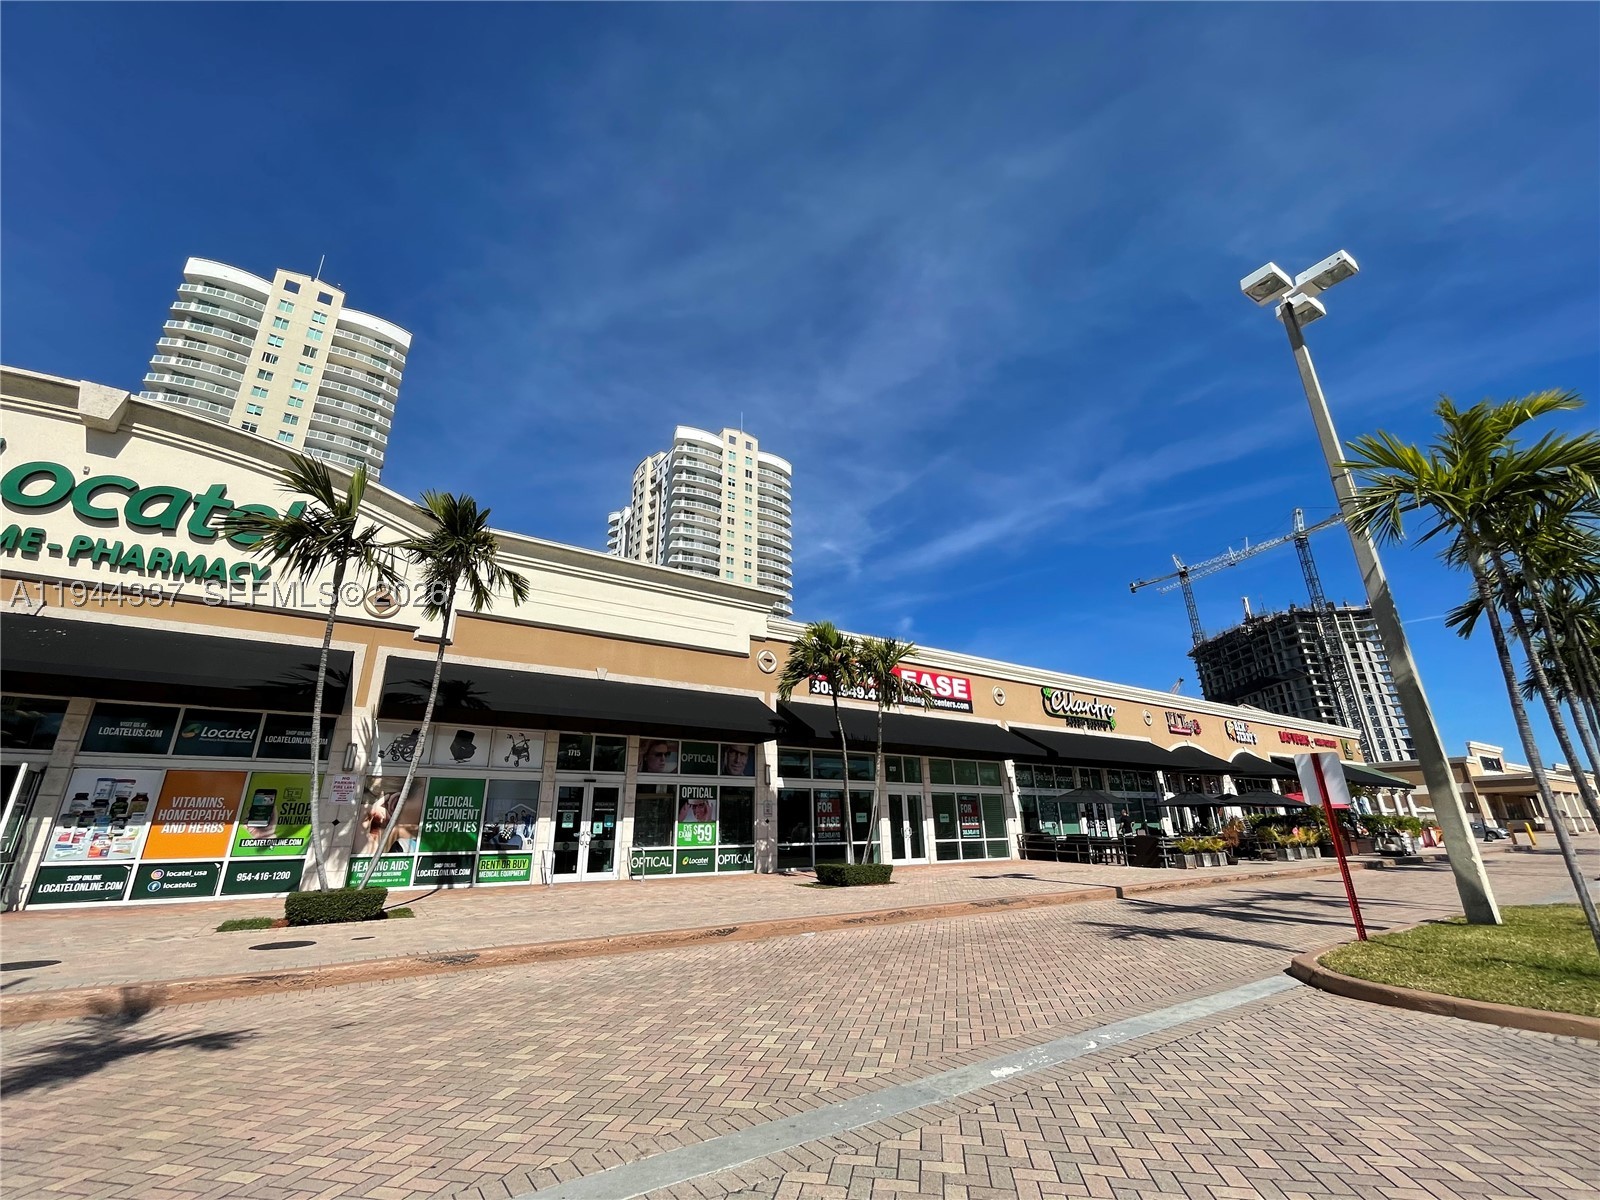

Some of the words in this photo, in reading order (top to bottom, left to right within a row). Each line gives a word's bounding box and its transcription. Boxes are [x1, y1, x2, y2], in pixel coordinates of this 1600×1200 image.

[67, 535, 271, 590] PHARMACY
[1051, 690, 1116, 717] Cilantro
[98, 726, 164, 738] LOCATELUS.COM
[201, 726, 256, 740] Locatel
[681, 753, 716, 764] OPTICAL
[681, 786, 714, 799] OPTICAL
[172, 796, 226, 809] VITAMINS,
[433, 795, 474, 808] MEDICAL
[817, 802, 833, 813] FOR
[426, 808, 479, 820] EQUIPMENT
[960, 803, 972, 813] FOR
[158, 809, 234, 821] HOMEOPATHY
[161, 823, 185, 834] AND
[188, 822, 225, 833] HERBS
[425, 823, 432, 833] &
[435, 821, 477, 833] SUPPLIES
[817, 816, 840, 828] LEASE
[241, 838, 303, 847] LOCATELONLINE.COM
[480, 860, 500, 870] RENT
[501, 860, 511, 869] OR
[512, 859, 527, 869] BUY
[631, 856, 672, 869] OPTICAL
[689, 856, 709, 864] Locatel
[718, 853, 753, 864] OPTICAL
[351, 861, 389, 872] HEAING
[390, 860, 410, 871] AIDS
[166, 868, 207, 878] locatel_usa
[236, 871, 291, 882] 954-416-1200
[416, 868, 471, 877] LOCATELONLINE.COM
[479, 870, 500, 878] MEDICAL
[500, 870, 527, 878] EQUIPMENT
[38, 881, 124, 893] LOCATELONLINE.COM
[163, 881, 197, 889] locatelus
